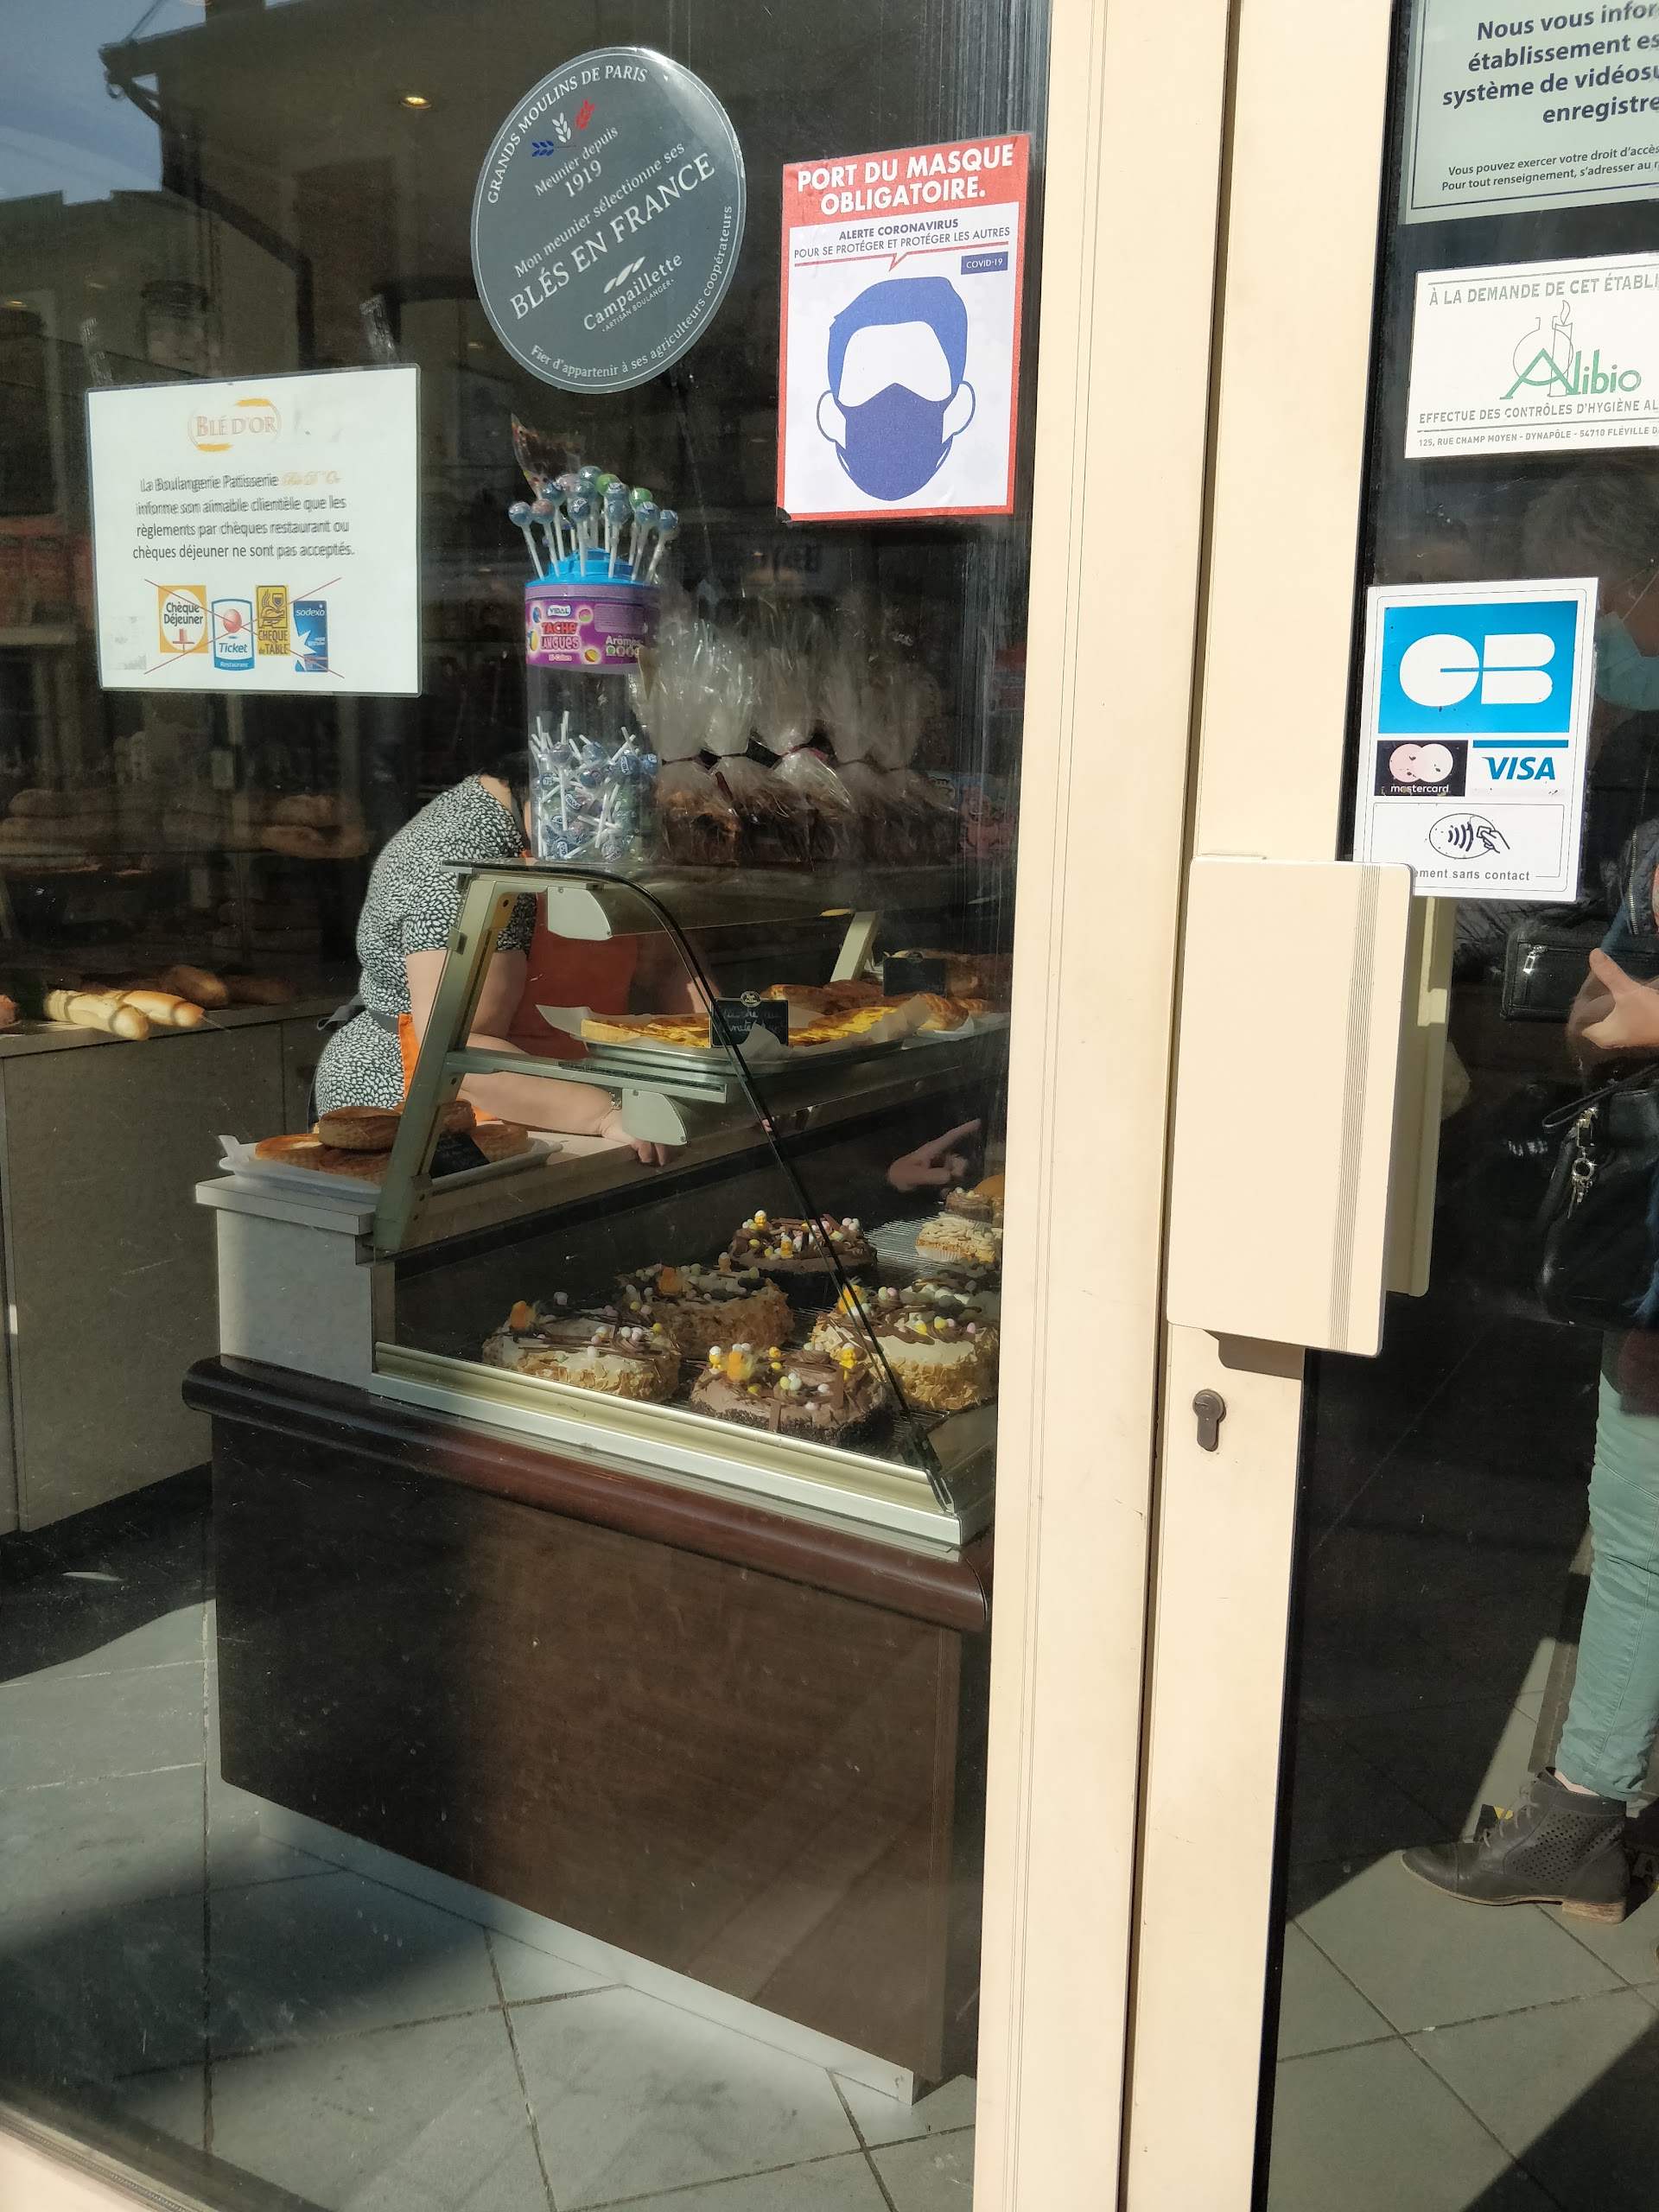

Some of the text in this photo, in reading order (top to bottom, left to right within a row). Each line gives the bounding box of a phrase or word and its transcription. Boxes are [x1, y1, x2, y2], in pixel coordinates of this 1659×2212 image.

[1477, 0, 1659, 41] Nous vous infor
[1468, 35, 1631, 72] établissement
[1442, 80, 1535, 110] système
[1540, 73, 1569, 93] de
[1542, 95, 1659, 124] enregistre
[486, 65, 648, 204] GRANDS MOULINS DE PARIS
[534, 126, 619, 196] Meunier depuis
[798, 143, 1014, 193] PORT DU MASQUE
[1448, 166, 1474, 176] Vous
[1476, 162, 1516, 175] pouvez
[1517, 156, 1557, 168] exercer
[1559, 153, 1588, 164] votre
[1591, 148, 1618, 161] droit
[564, 159, 602, 198] 1919
[1441, 181, 1466, 191] Pour
[1468, 177, 1491, 188] tout
[1493, 168, 1578, 185] renseignement,
[1637, 162, 1651, 170] au
[514, 143, 685, 277] Mon meunier sélectionne ses
[820, 175, 987, 216] OBLIGATOIRE.
[509, 152, 715, 320] BLÉS EN FRANCE
[794, 226, 1011, 259] POUR SE PROTÉGER ET PROTÉGER LES AUTRES
[839, 218, 959, 241] ALERTE CORONAVIRUS
[531, 344, 551, 365] Fier
[621, 360, 629, 373] à
[631, 354, 649, 370] ses
[650, 297, 706, 359] agriculteurs
[703, 206, 733, 296] coopérateurs
[583, 254, 683, 331] Campaillette
[1429, 288, 1439, 306] À
[1444, 289, 1462, 305] LA
[1467, 283, 1540, 303] DEMANDE
[1545, 281, 1566, 296] DE
[1569, 277, 1600, 295] CET
[1499, 347, 1642, 400] Alibio
[196, 415, 228, 437] BLÉ
[1419, 409, 1476, 424] EFFECTUE
[1479, 408, 1501, 420] DES
[1504, 402, 1573, 419] CONTRÔLES
[1418, 437, 1435, 448] 125,
[1436, 436, 1454, 447] RUE
[1455, 435, 1485, 445] CHAMP
[1487, 433, 1517, 443] MOYEN
[1525, 429, 1572, 441] DYNAPÔLE
[1580, 429, 1605, 438] 54710
[1607, 425, 1649, 436] FLÉVILLE
[140, 478, 154, 493] La
[155, 474, 221, 493] Boulangerie
[136, 494, 347, 516] informe son aimable clientèle que les
[137, 520, 350, 540] règlements par chèques restaurant ou
[132, 541, 356, 562] chèques déjeuner ne sont pas acceptés.
[163, 613, 204, 627] Déjeuner
[166, 601, 200, 615] Chèque
[296, 607, 326, 617] sodexo
[219, 642, 249, 653] Ticket
[265, 643, 289, 655] TABLE
[1481, 756, 1556, 780] VISA
[1452, 870, 1480, 880] sans
[1484, 870, 1531, 881] contact
